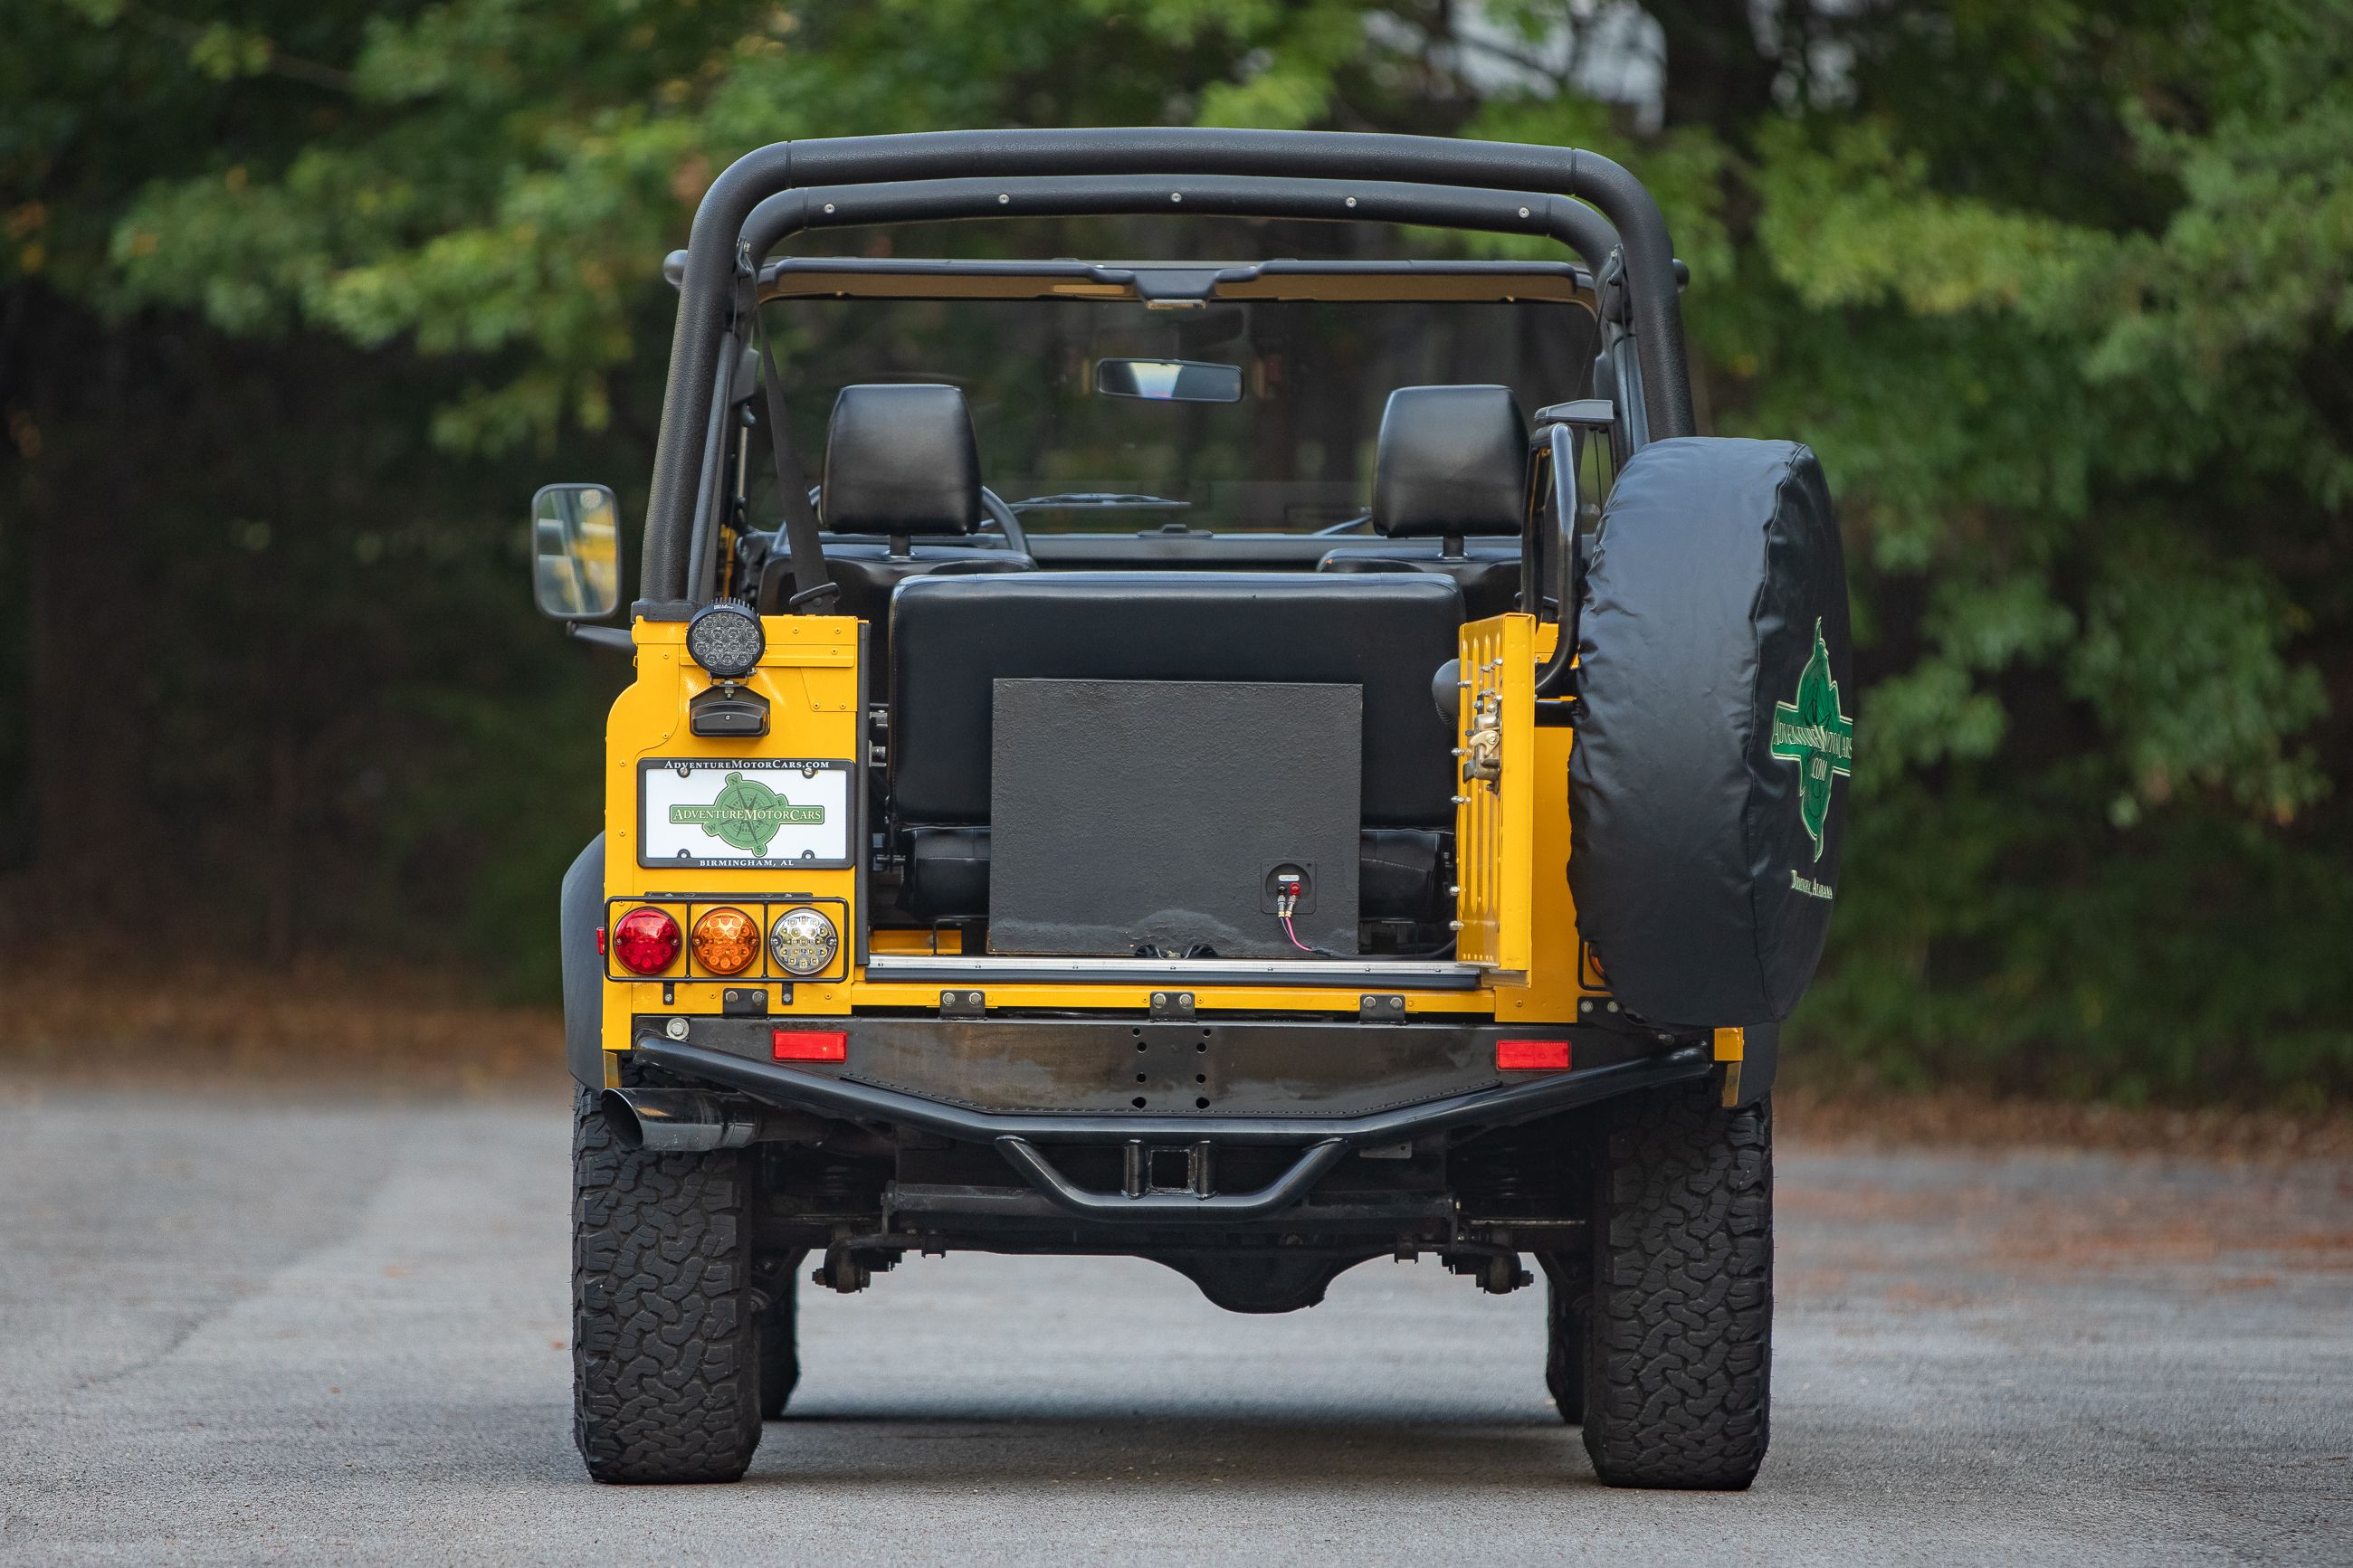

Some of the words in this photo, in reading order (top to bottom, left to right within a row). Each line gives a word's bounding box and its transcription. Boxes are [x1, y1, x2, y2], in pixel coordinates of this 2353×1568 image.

[664, 760, 830, 769] ADVENTUREMOTORCARS.COM
[729, 776, 739, 785] N
[672, 809, 821, 821] ADVENTUREMOTORCARS
[708, 823, 717, 832] W
[757, 845, 763, 853] S
